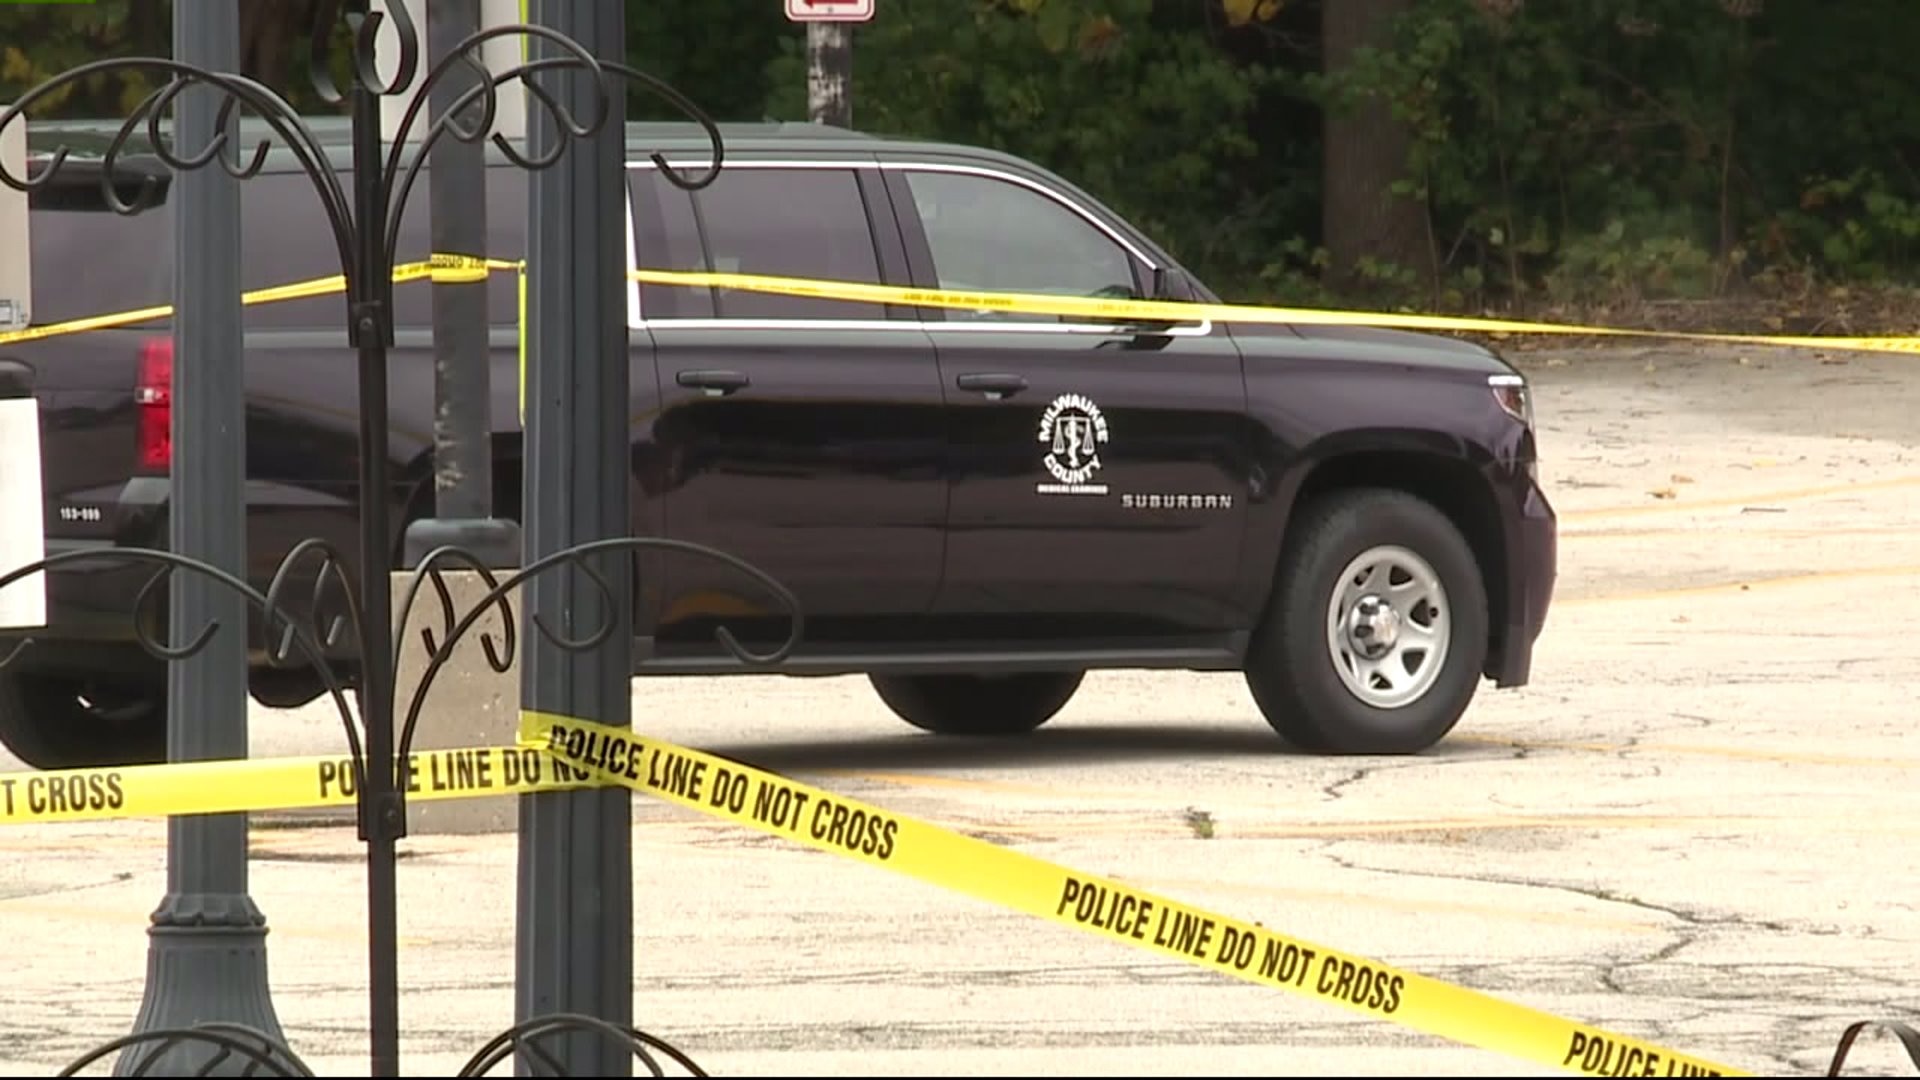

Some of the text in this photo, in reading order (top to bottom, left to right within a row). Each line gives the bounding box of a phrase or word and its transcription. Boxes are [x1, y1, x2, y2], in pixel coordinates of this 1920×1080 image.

[1039, 394, 1109, 443] MILWAUKEE
[1044, 453, 1101, 484] COUNTY
[1122, 494, 1232, 509] SUBURBAN
[431, 749, 492, 791] LINE
[503, 747, 541, 786] DO
[28, 773, 123, 814] CROSS
[547, 725, 644, 780] POLICE
[648, 749, 707, 801] LINE
[710, 768, 748, 813] DO
[753, 780, 808, 831] NOT
[811, 799, 898, 860] CROSS
[1057, 877, 1405, 1014] POLICE LINE DO NOT CROSS
[1563, 1030, 1660, 1077] POLICE
